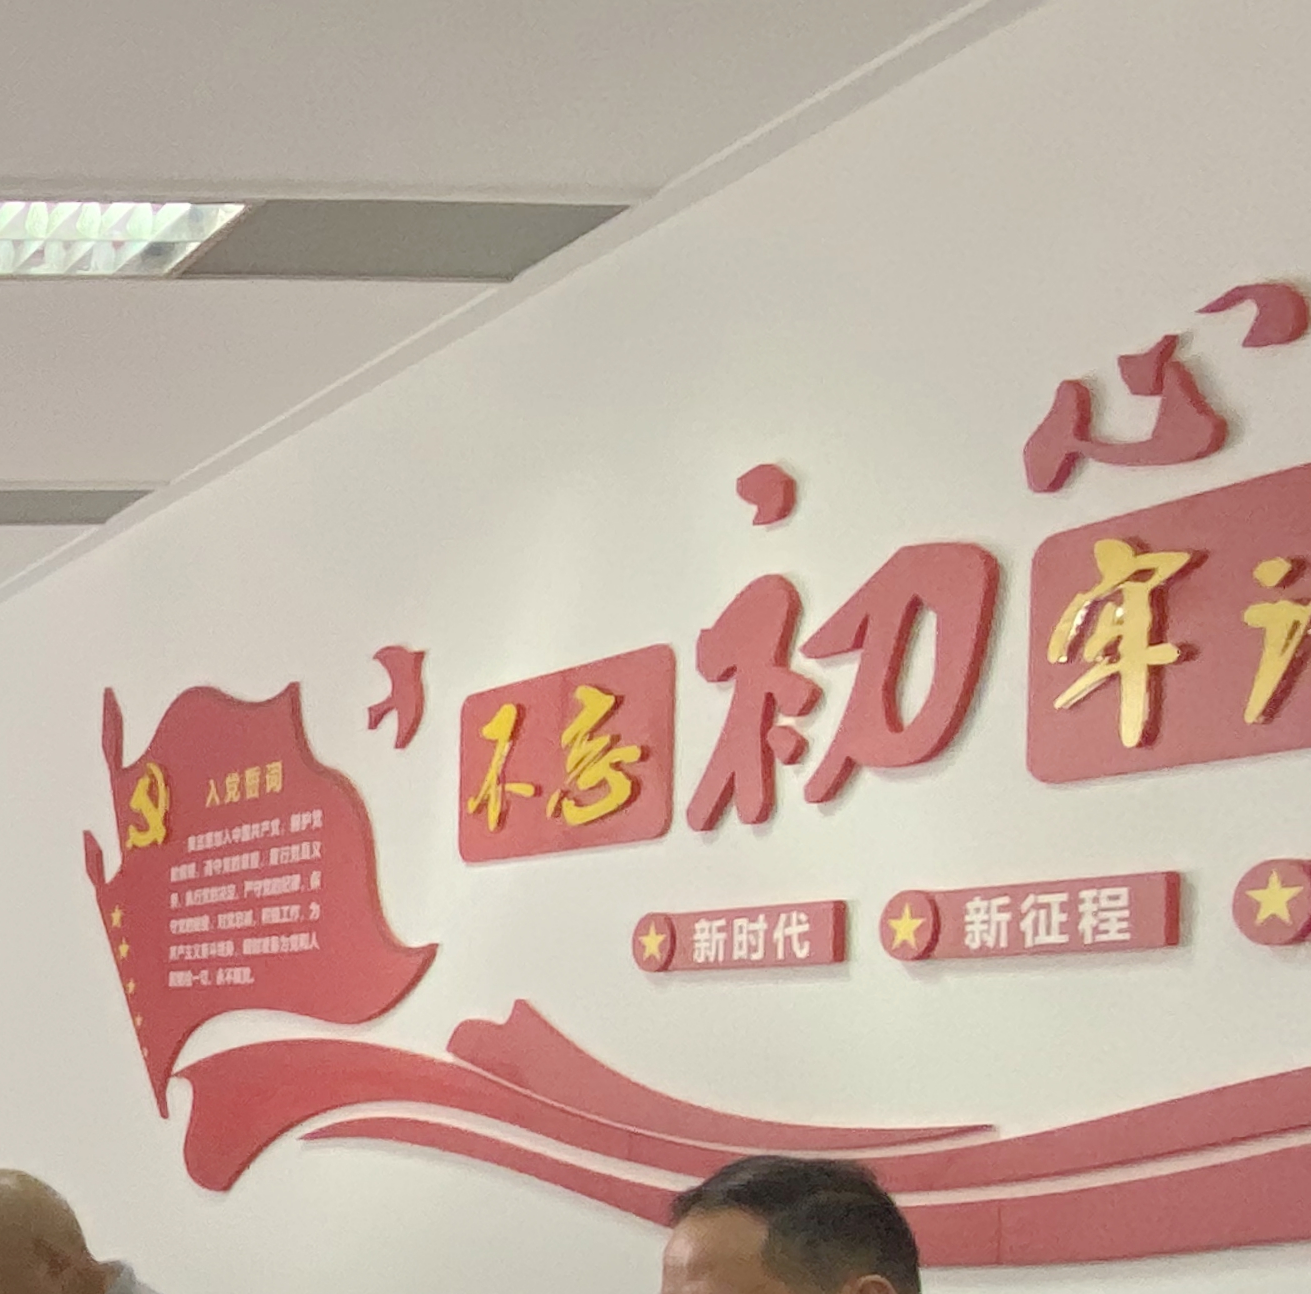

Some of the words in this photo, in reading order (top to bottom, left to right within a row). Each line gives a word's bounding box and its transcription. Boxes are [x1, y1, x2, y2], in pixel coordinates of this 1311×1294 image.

[691, 909, 812, 965] 新时代
[963, 884, 1133, 952] 新征程
